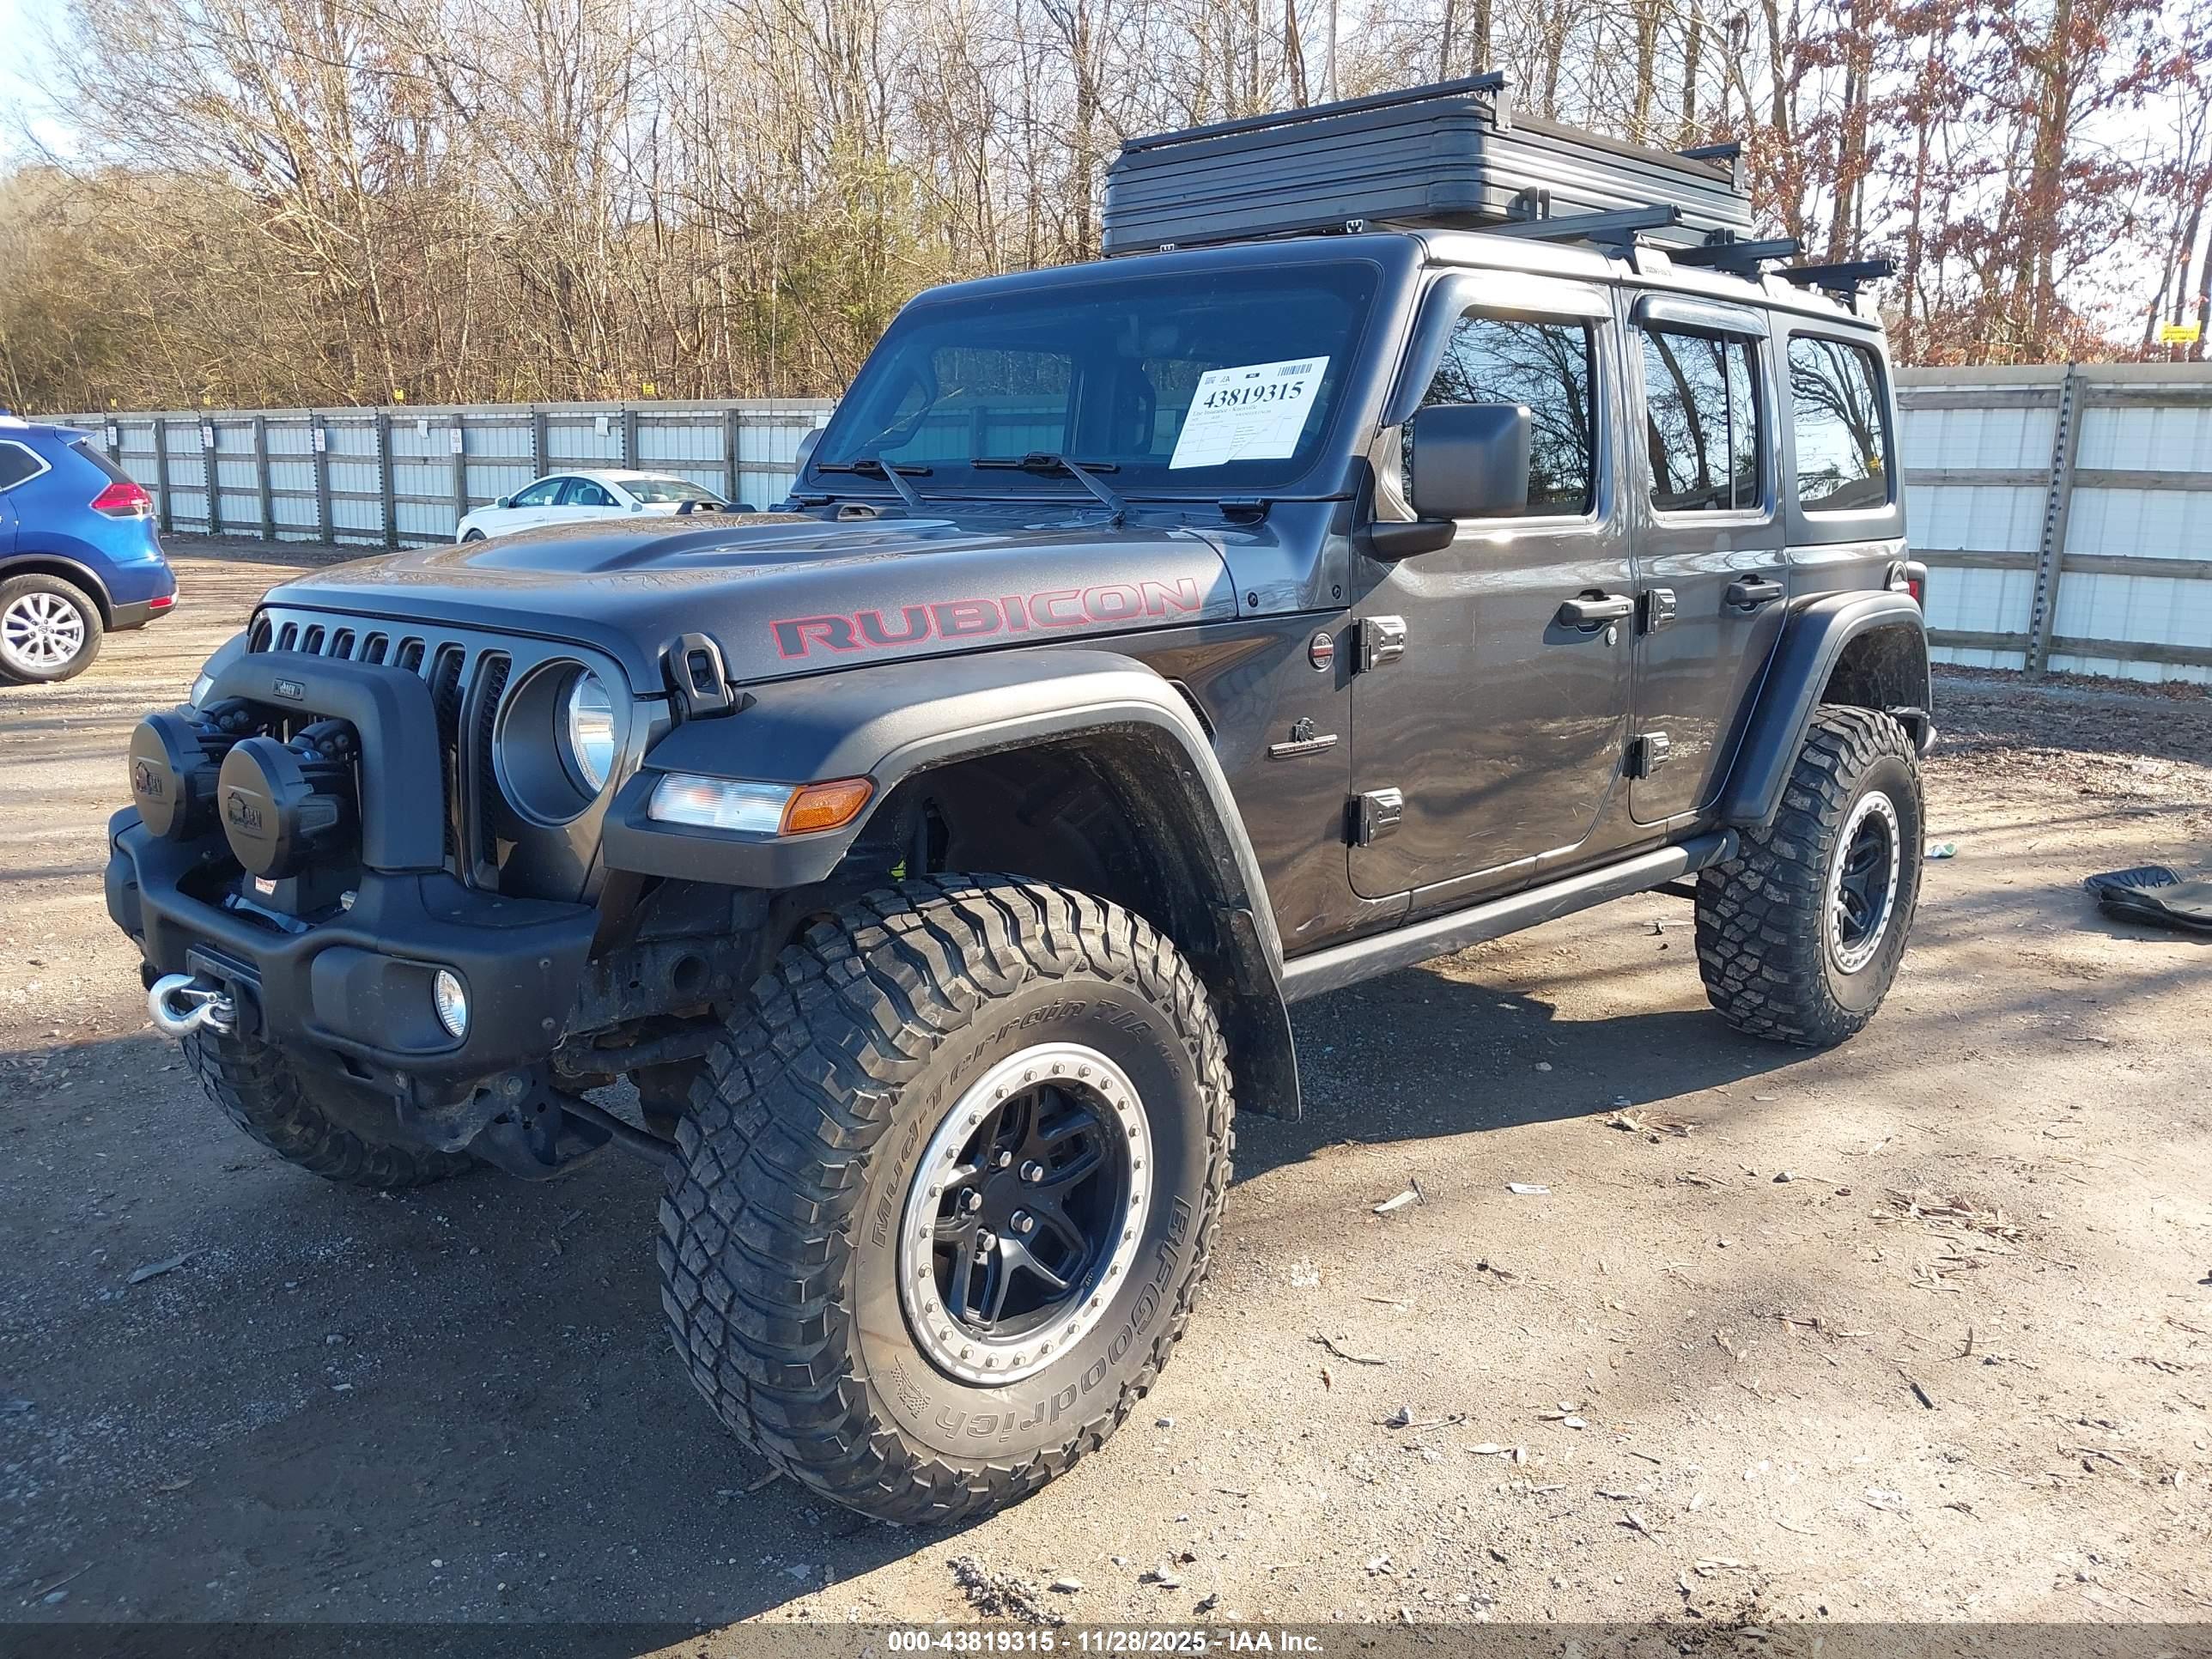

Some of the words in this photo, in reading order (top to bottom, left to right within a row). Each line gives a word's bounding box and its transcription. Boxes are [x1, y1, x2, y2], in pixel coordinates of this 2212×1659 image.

[1203, 380, 1304, 409] 43819315
[769, 577, 1201, 659] RUBICON
[872, 998, 1086, 1249] Mud-Terrain
[935, 1194, 1193, 1443] BFGoodrich
